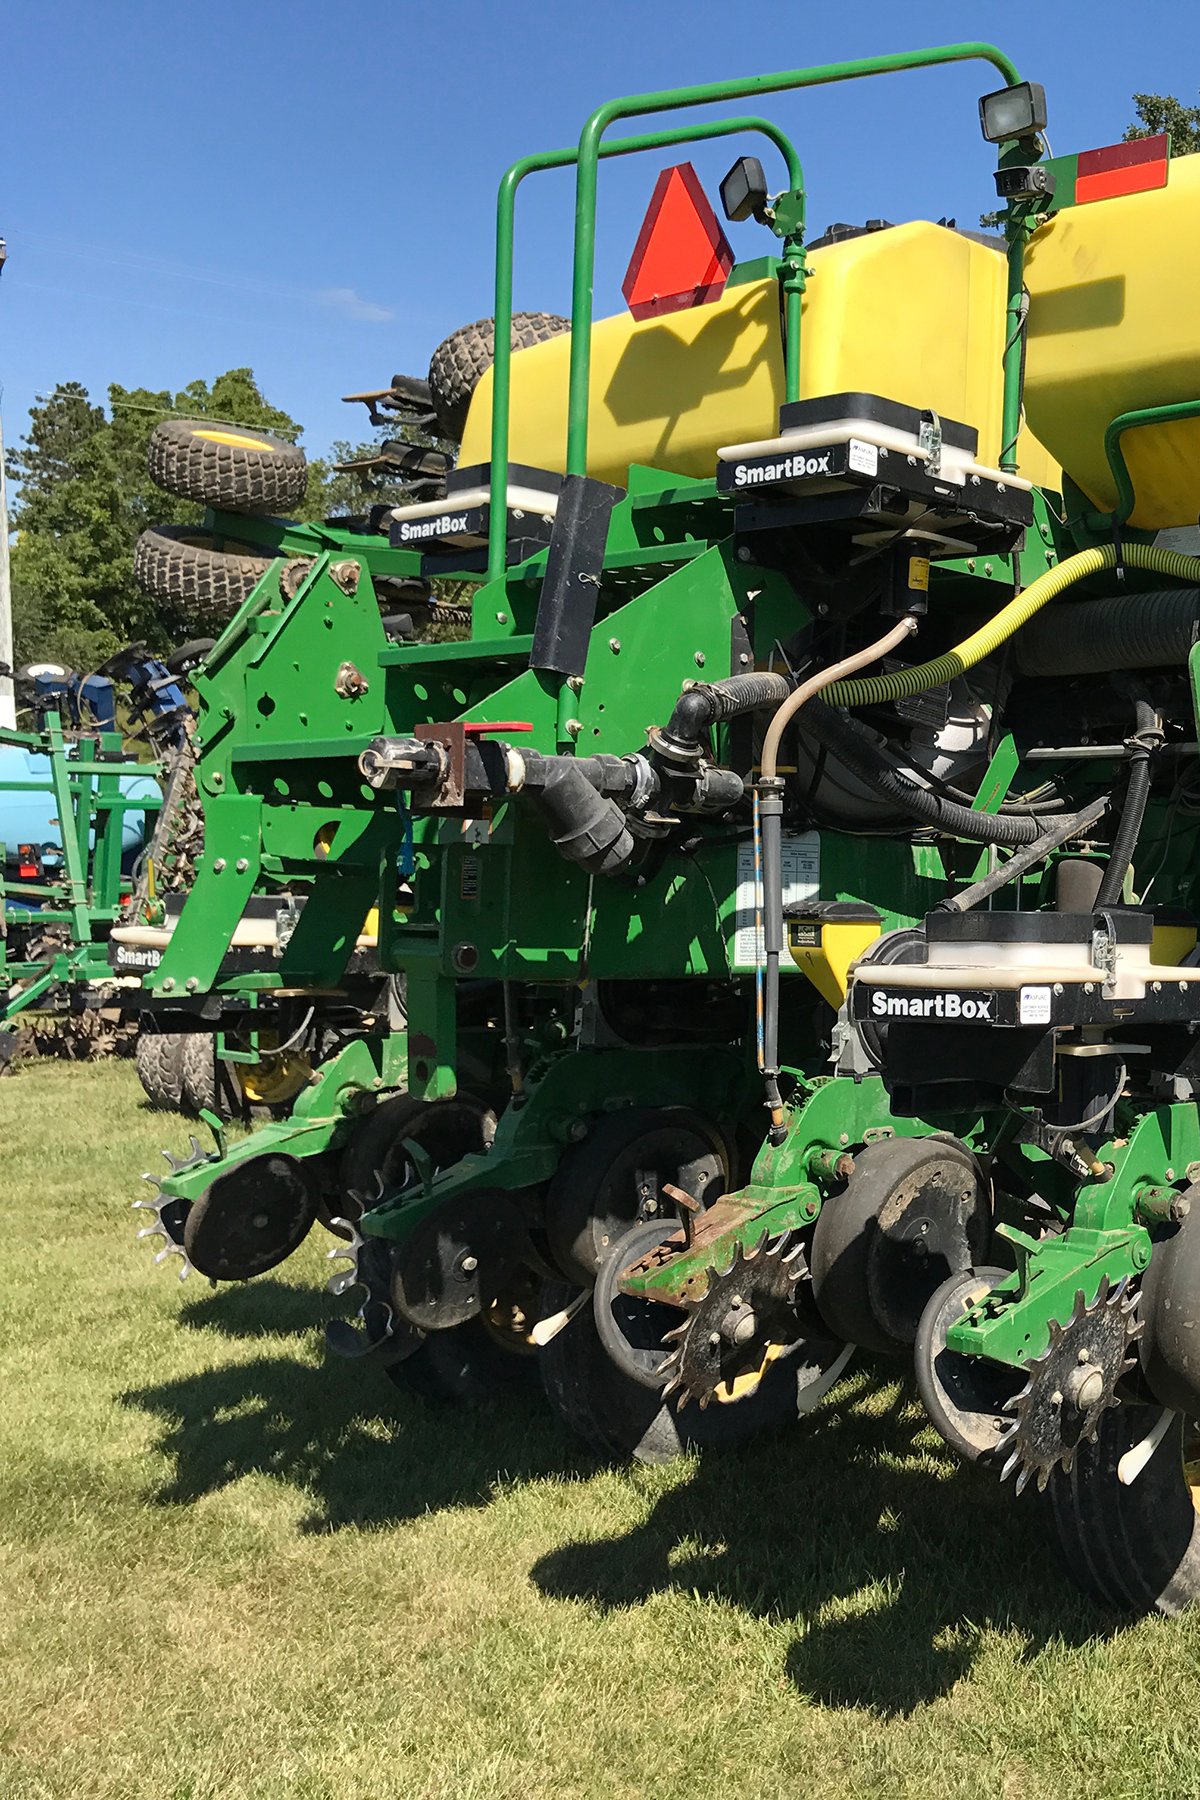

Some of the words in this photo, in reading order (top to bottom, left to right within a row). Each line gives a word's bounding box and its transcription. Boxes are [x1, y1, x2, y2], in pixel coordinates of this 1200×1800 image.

[734, 455, 829, 486] SmartBox
[400, 515, 467, 541] SmartBox
[117, 946, 164, 967] SmartB
[872, 991, 991, 1019] SmartBox
